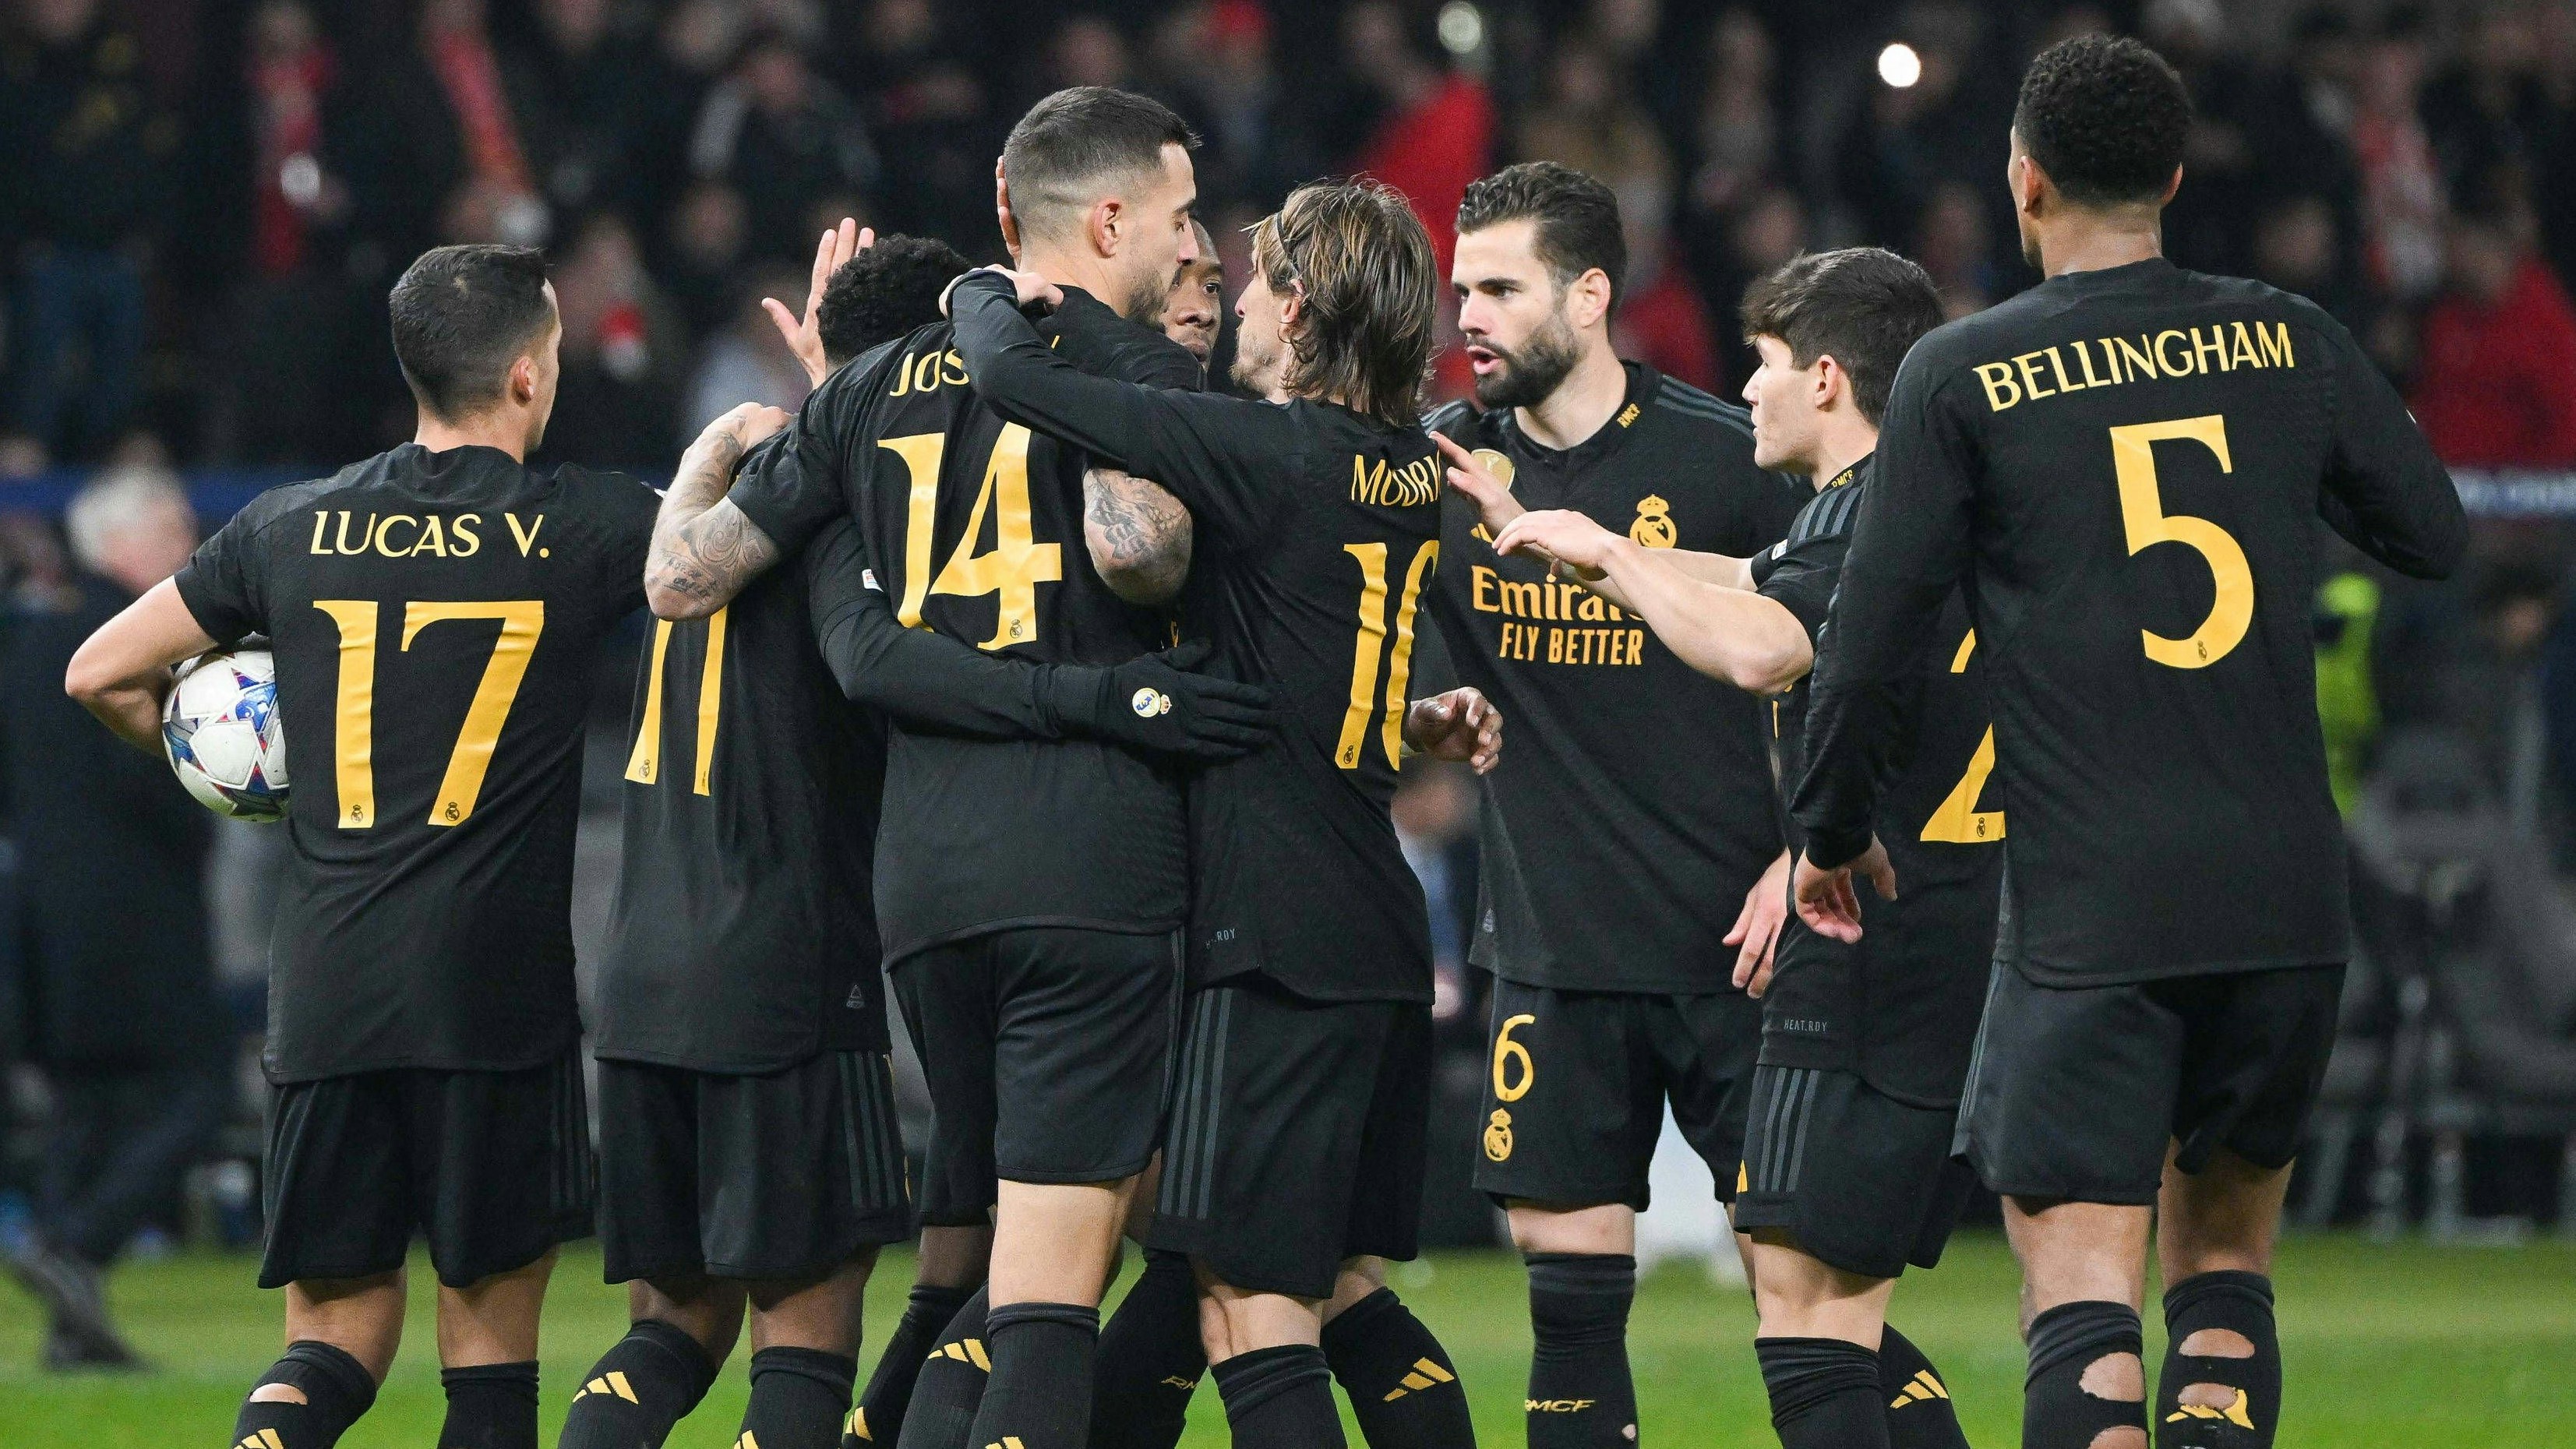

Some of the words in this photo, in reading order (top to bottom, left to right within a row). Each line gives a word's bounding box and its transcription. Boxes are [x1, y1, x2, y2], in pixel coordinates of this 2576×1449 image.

[889, 348, 970, 397] JOS
[1974, 320, 2295, 412] BELLINGHAM
[1350, 448, 1442, 507] MODRI
[309, 509, 482, 559] LUCAS
[504, 512, 550, 559] V.
[877, 421, 1062, 652] 14
[2108, 414, 2254, 669] 5
[1471, 565, 1646, 622] Emira
[1498, 622, 1540, 662] FLY
[1547, 627, 1645, 666] BETTER
[312, 600, 545, 829] 17
[624, 602, 728, 797] 11
[1492, 1013, 1536, 1103] 6
[1784, 1017, 1828, 1033] HEAT.RDY
